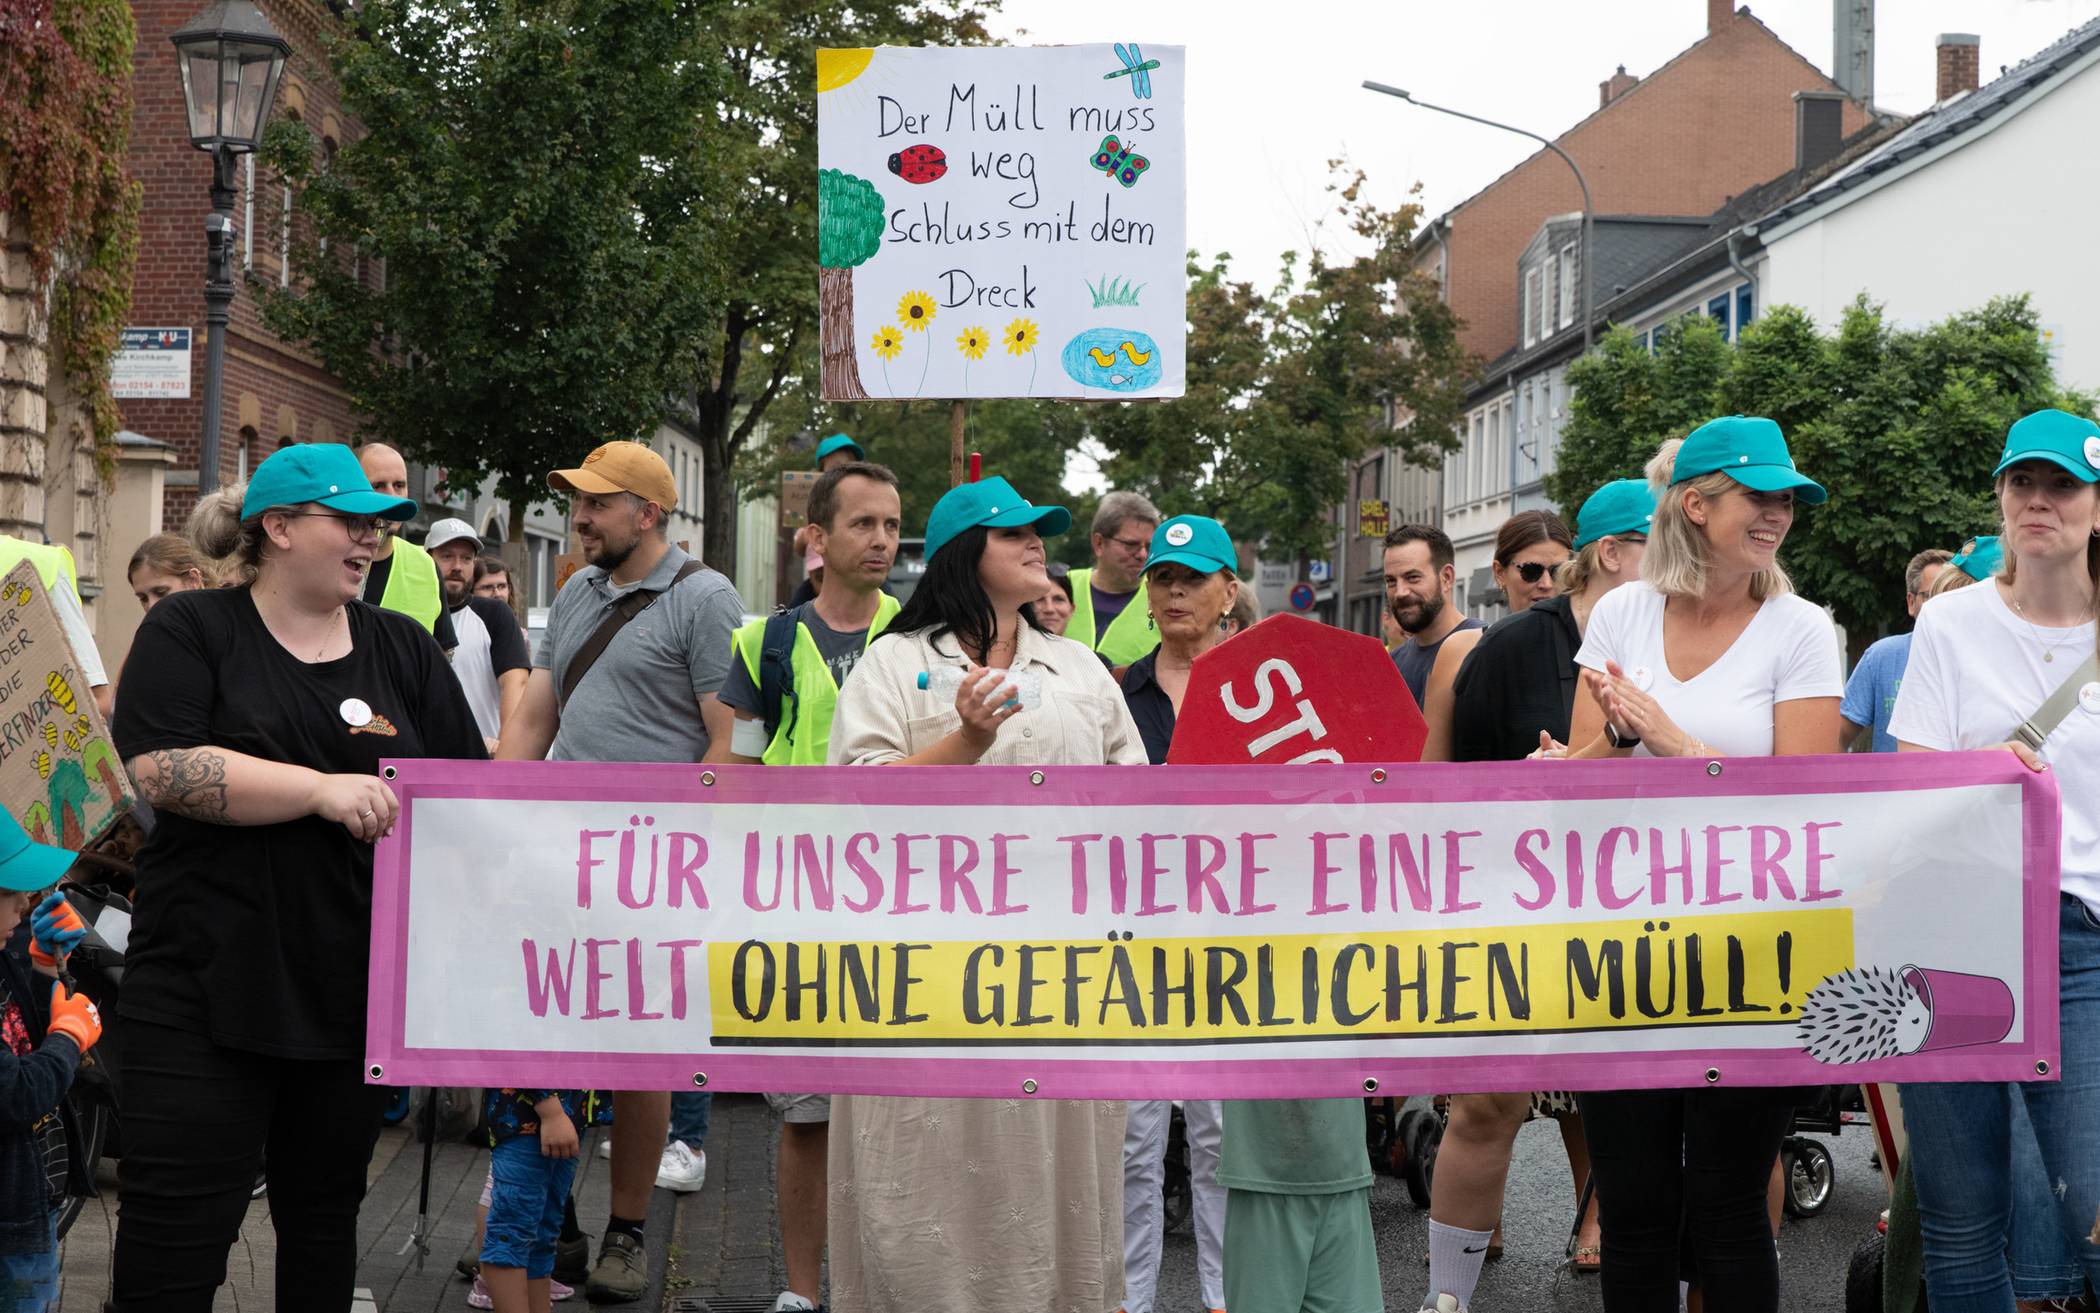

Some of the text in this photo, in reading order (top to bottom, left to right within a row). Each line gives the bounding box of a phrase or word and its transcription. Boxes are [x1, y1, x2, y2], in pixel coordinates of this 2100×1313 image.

[877, 83, 1156, 138] Der Müll muss
[971, 151, 1039, 209] weg
[888, 192, 1154, 246] Schluss mit dem
[938, 265, 1036, 309] Dreck
[1361, 520, 1389, 537] HALLE
[0, 689, 59, 768] ERFINDER
[576, 815, 1842, 917] FÜR UNSERE TIERE EINE SICHERE
[521, 920, 1793, 1028] WELT OHNE GEFÄHRLICHEN MÜLL!
